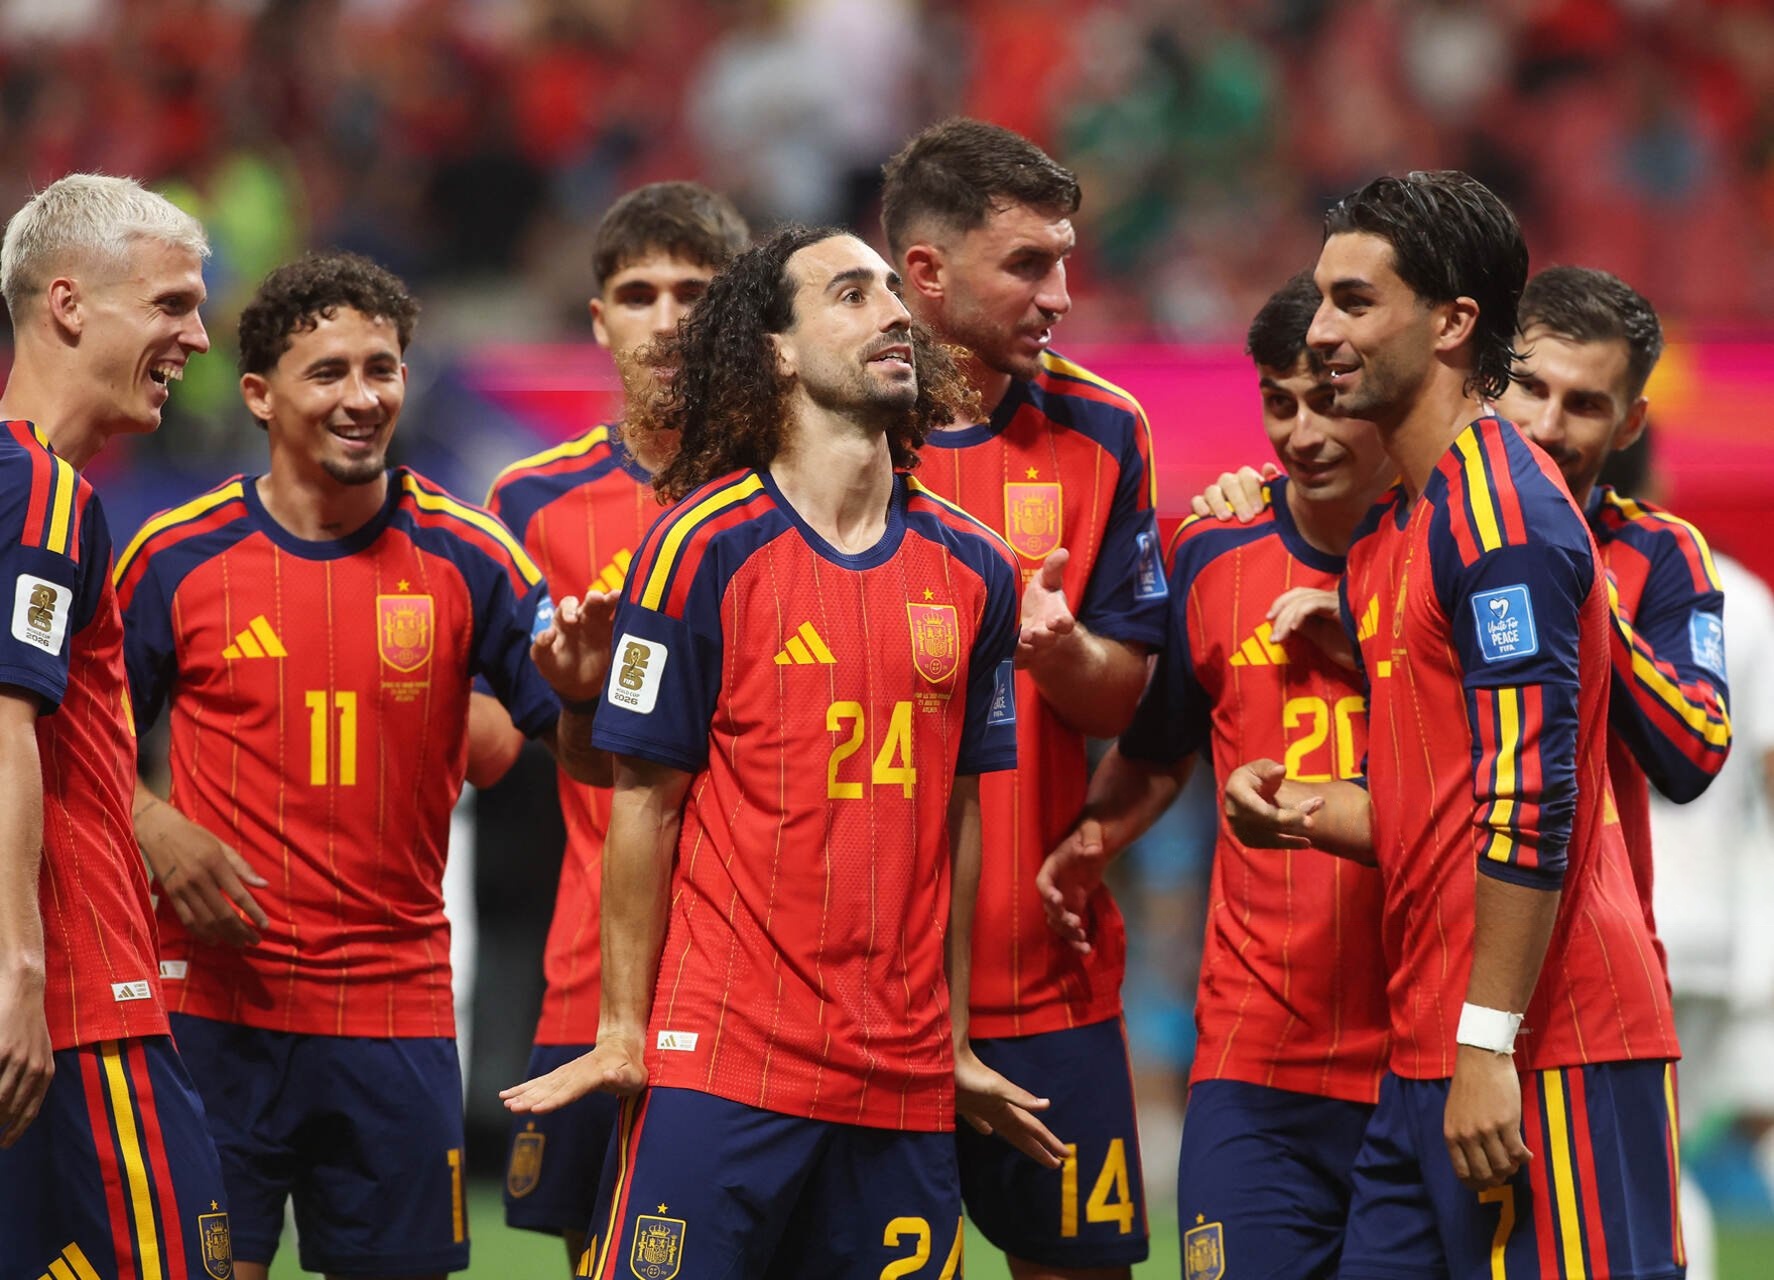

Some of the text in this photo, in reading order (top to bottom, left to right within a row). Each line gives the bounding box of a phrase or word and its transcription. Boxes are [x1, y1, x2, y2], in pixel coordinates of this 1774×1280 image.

[26, 632, 49, 647] 2026
[1491, 630, 1519, 646] PEACE
[1499, 644, 1516, 653] FIFA
[614, 692, 639, 706] 2026
[305, 690, 357, 786] 11
[826, 701, 917, 799] 24
[1058, 1138, 1135, 1238] 14
[1478, 1184, 1516, 1280] 7
